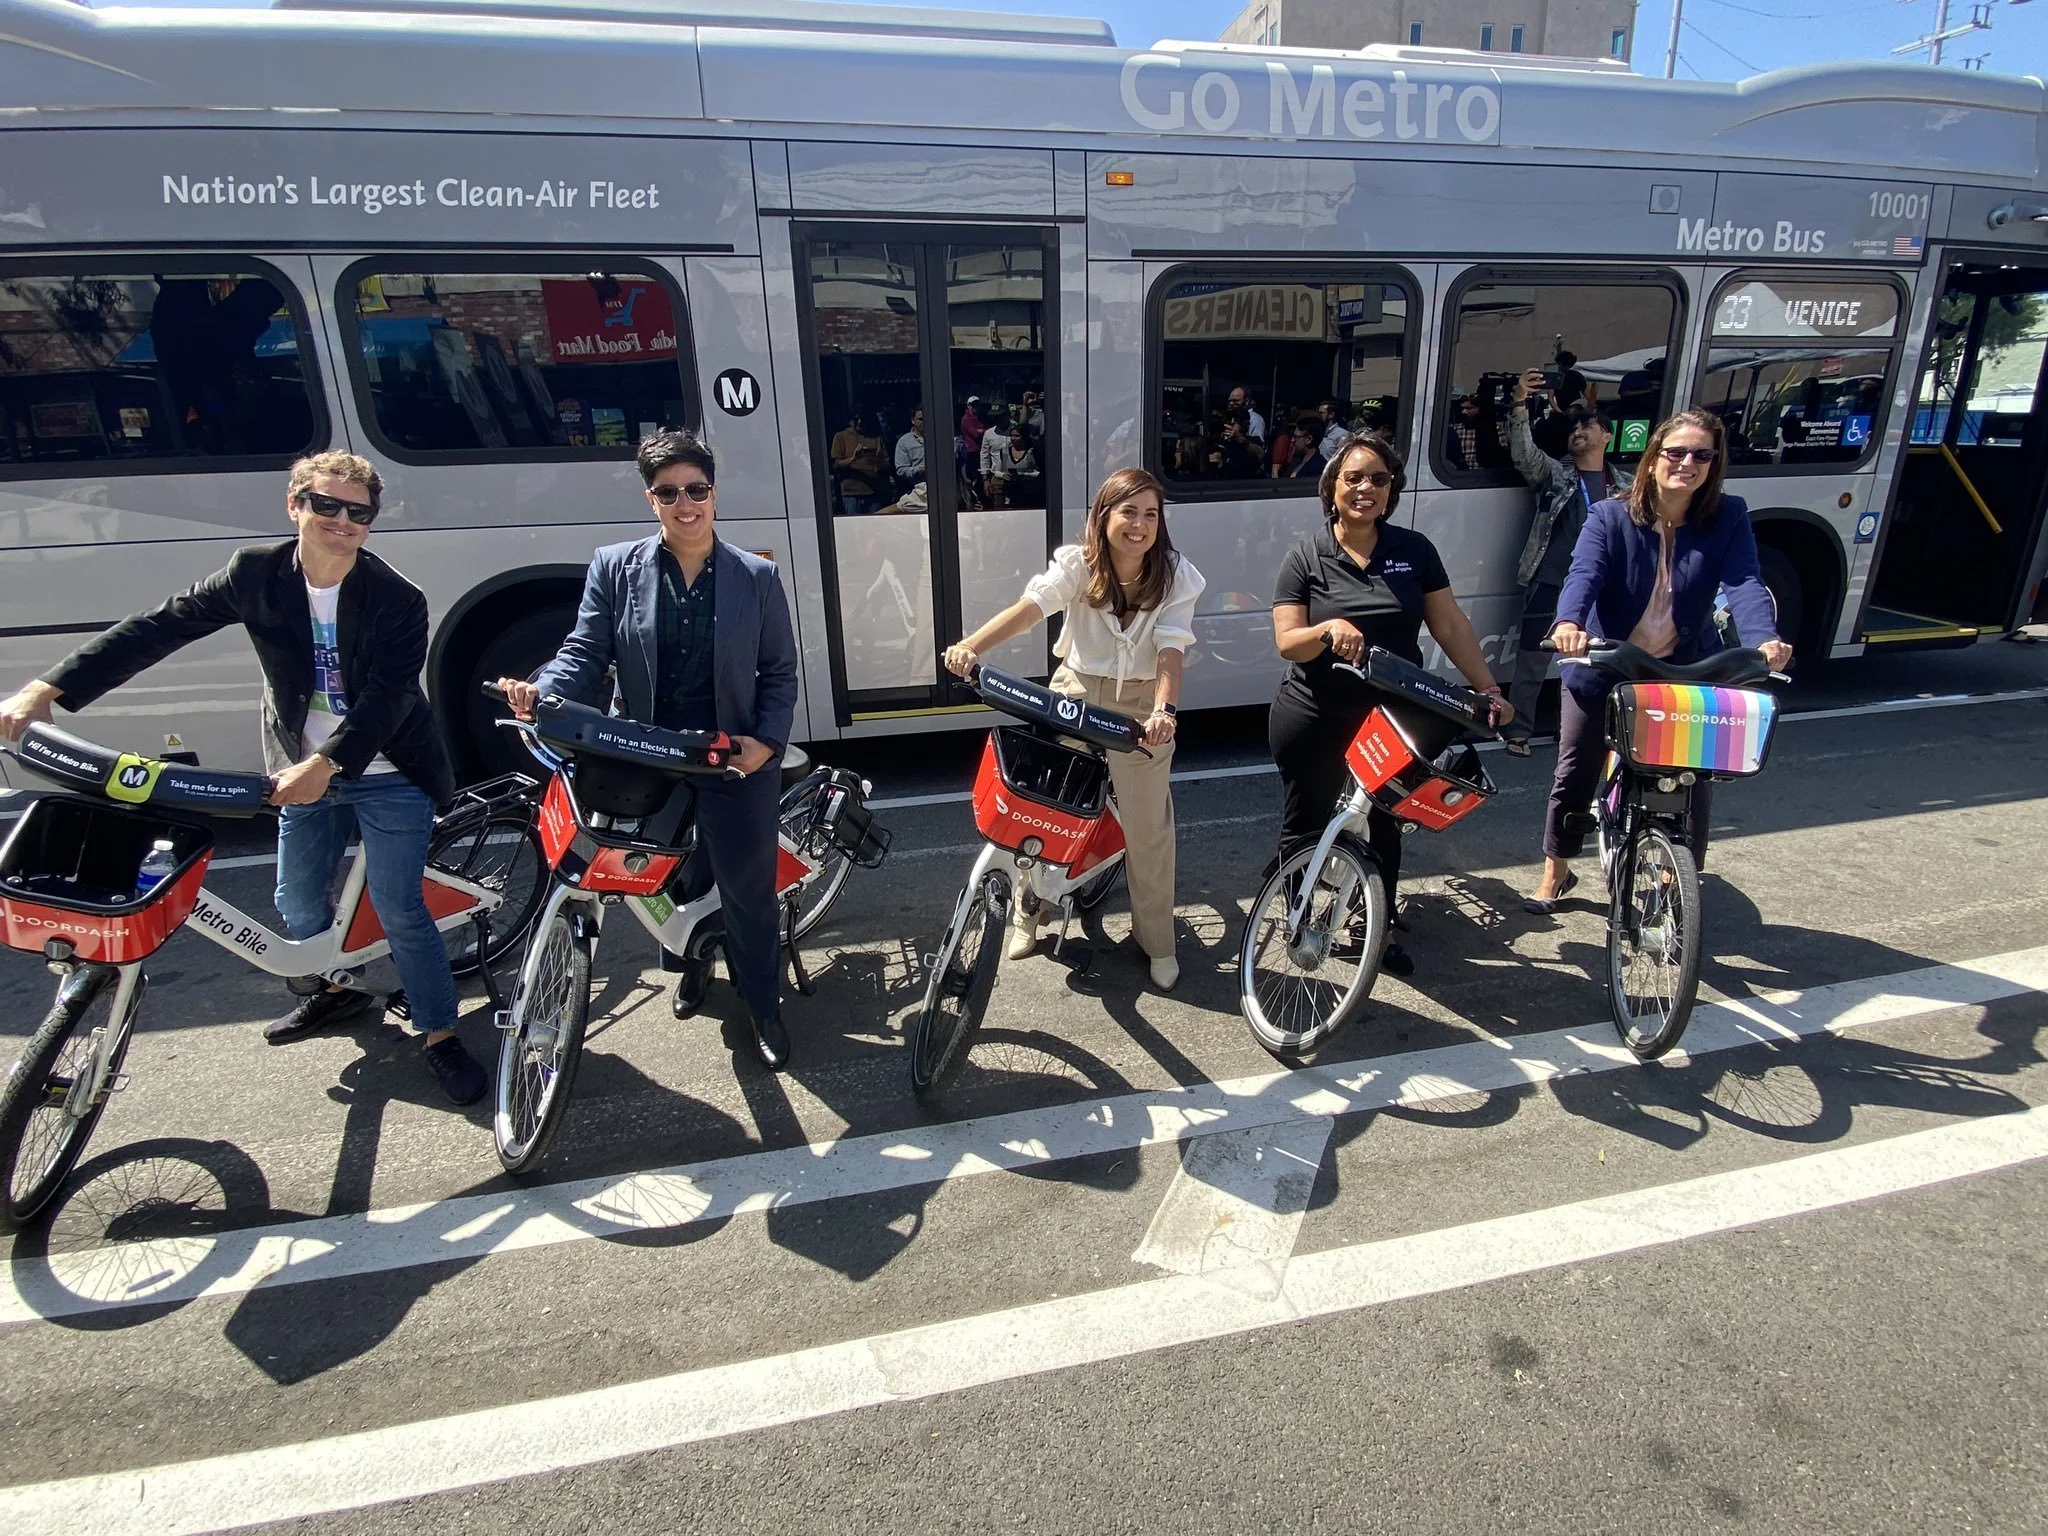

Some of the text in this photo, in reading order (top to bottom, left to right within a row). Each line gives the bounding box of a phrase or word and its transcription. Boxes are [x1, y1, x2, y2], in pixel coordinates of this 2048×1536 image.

[1120, 53, 1499, 142] Go Metro
[162, 174, 660, 214] Nation's Largest Clean-Air Fleet
[1869, 191, 1929, 220] 10001
[1676, 216, 1826, 254] Metro Bus
[1719, 294, 1862, 330] 33 VENICE
[987, 677, 998, 686] Hi!
[996, 681, 1007, 691] I'm
[1011, 688, 1029, 700] Metro
[1029, 695, 1044, 706] Bike.
[1415, 681, 1425, 691] Hi!
[1444, 694, 1463, 708] Electric
[1088, 714, 1101, 724] Take
[1670, 712, 1746, 726] DOORDASH
[28, 740, 100, 774] Hi! I'm a Metro Bike.
[598, 731, 612, 742] Hi!
[613, 733, 626, 745] I'm
[628, 740, 639, 748] an
[640, 740, 669, 754] Electric
[669, 747, 687, 758] Bike.
[1365, 738, 1384, 764] from your
[1372, 731, 1390, 757] Get more
[122, 768, 147, 786] M
[170, 779, 190, 789] Take
[207, 784, 220, 792] for
[227, 786, 249, 795] spin.
[1419, 803, 1452, 820] DOORDASH
[1012, 811, 1087, 840] DOORDASH
[607, 874, 657, 884] DOORDASH
[655, 903, 668, 922] Bike
[11, 915, 130, 938] DOORDASH
[191, 897, 268, 956] Metro Bike
